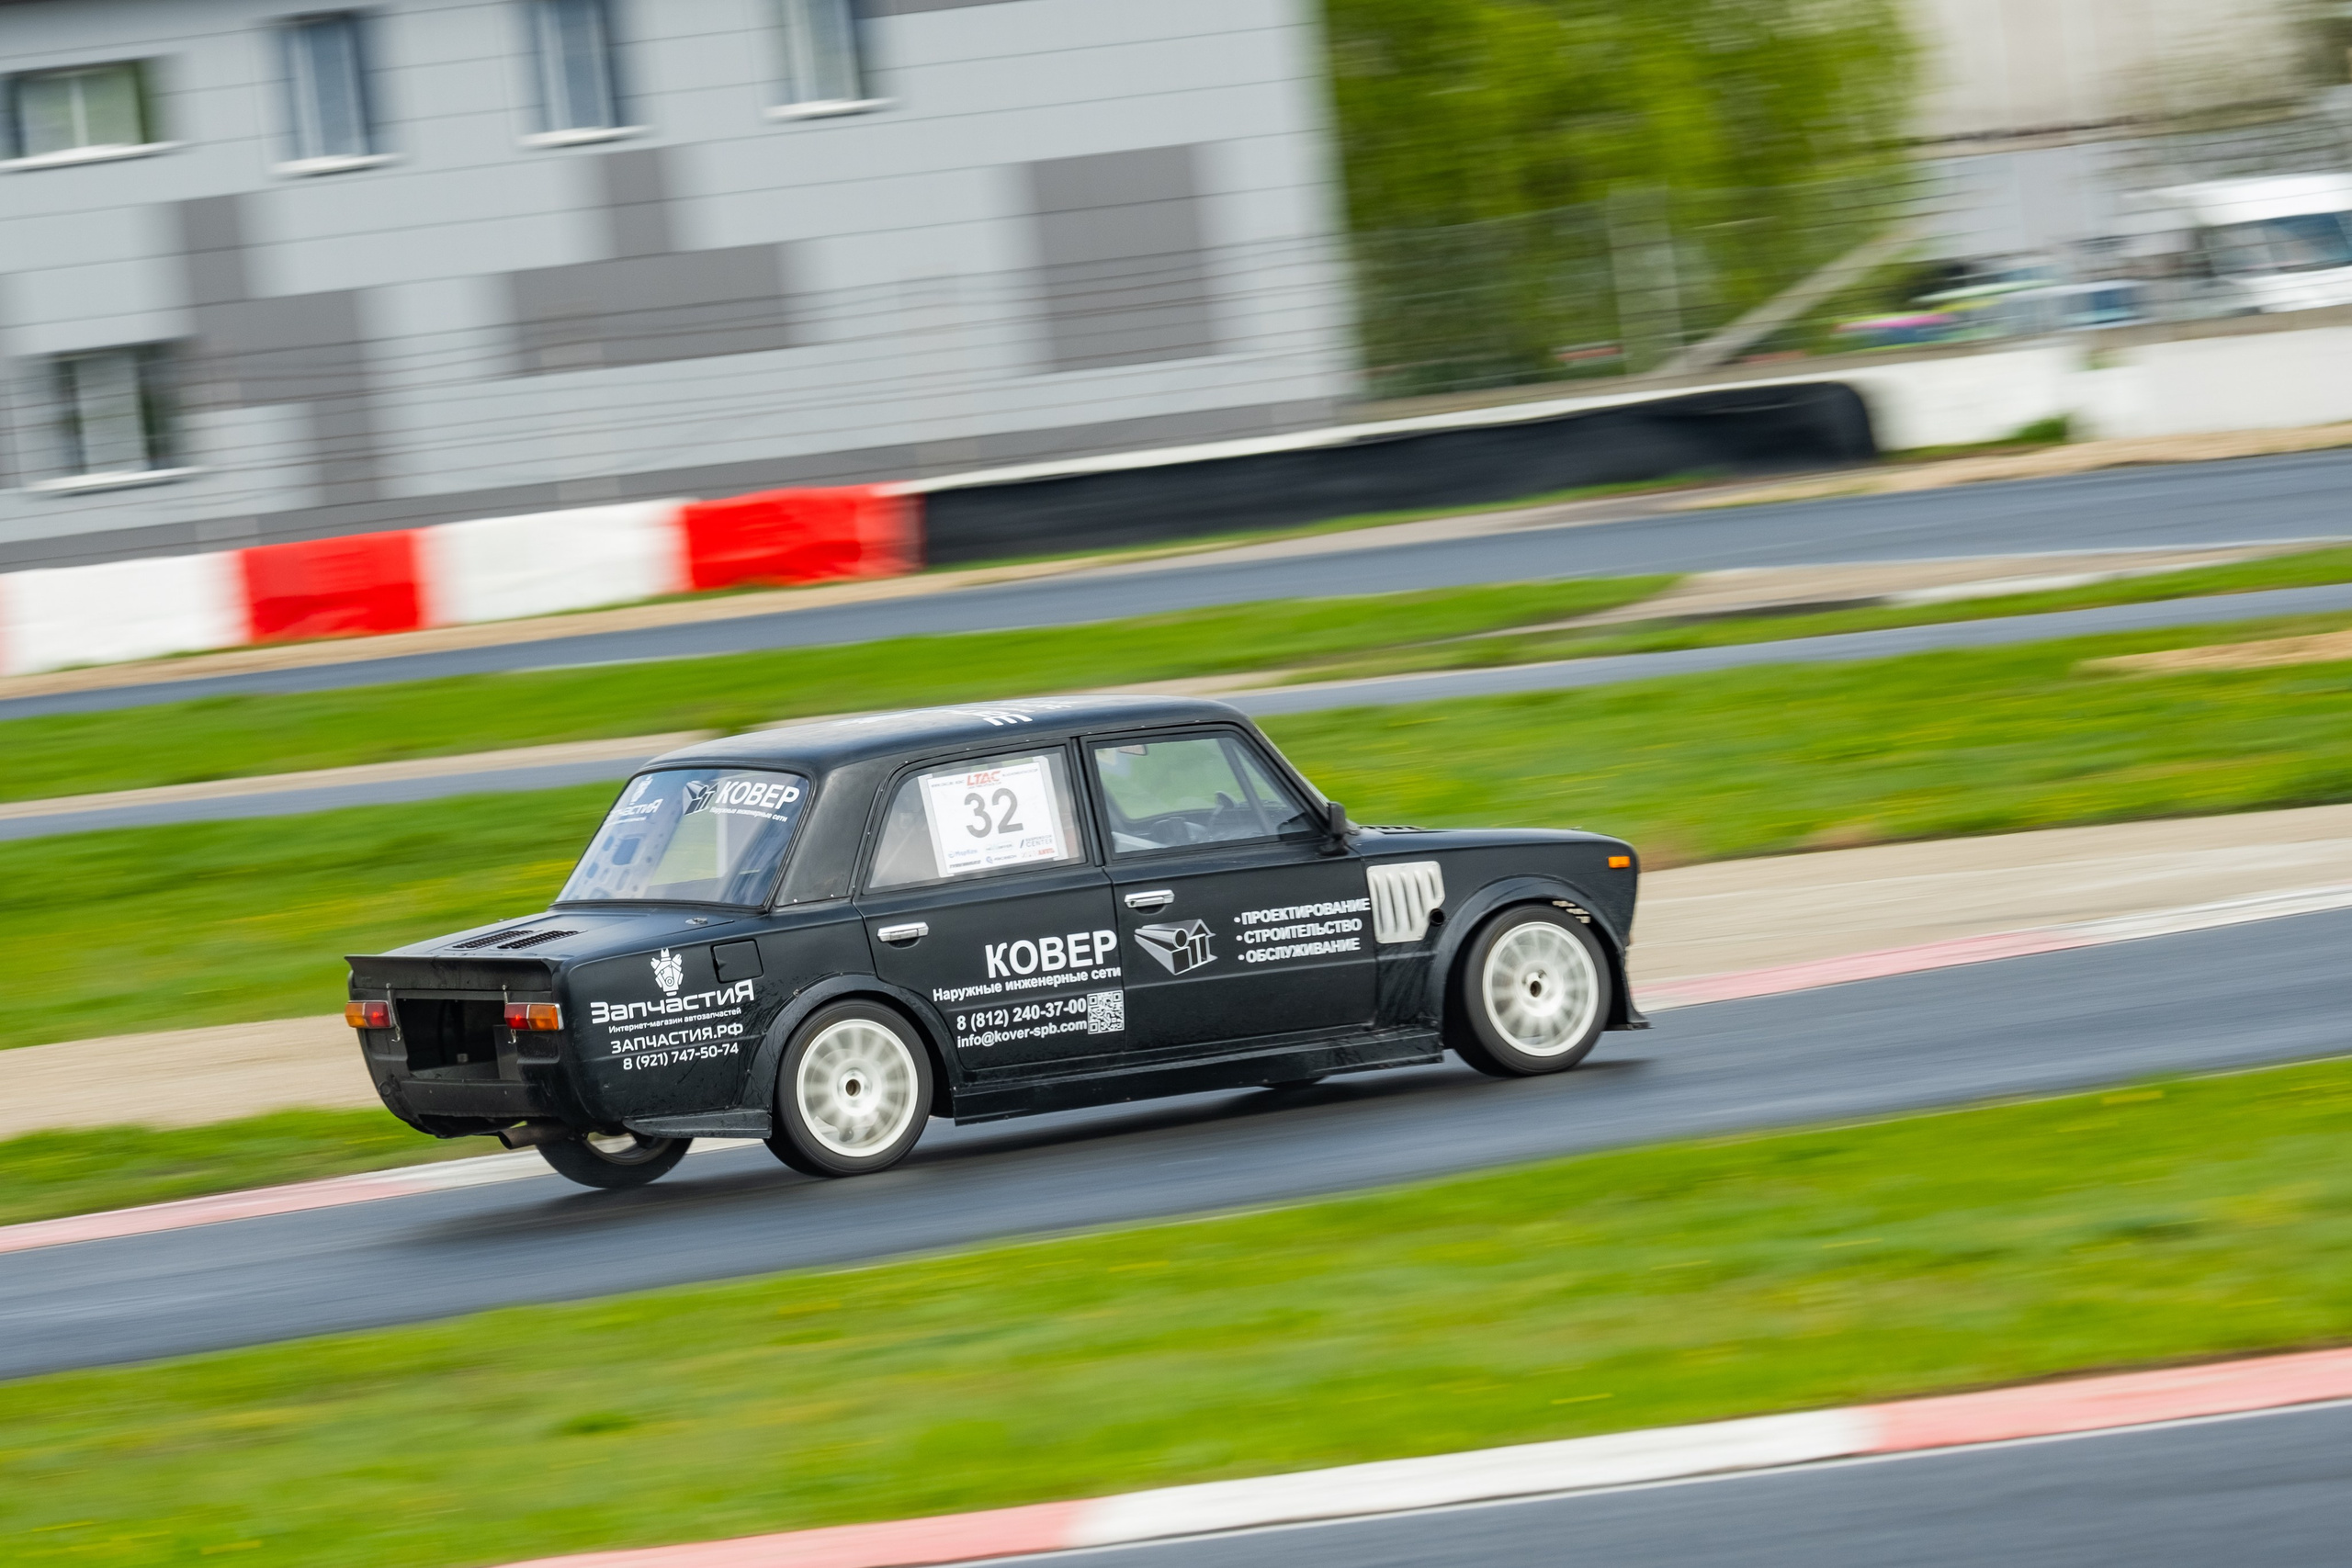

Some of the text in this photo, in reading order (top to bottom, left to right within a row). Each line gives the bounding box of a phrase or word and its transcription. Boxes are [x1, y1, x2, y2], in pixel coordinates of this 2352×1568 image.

[967, 771, 1001, 786] LTAC
[716, 781, 800, 810] КОВЕР
[964, 787, 1024, 839] 32
[1026, 839, 1053, 848] CENTER
[1241, 897, 1371, 925] ПРОЕКТИРОВАНИЕ
[1243, 919, 1363, 944] СТРОИТЕЛЬСТВО
[985, 930, 1118, 978] КОВЕР
[1246, 938, 1361, 963] ОБСЛУЖИВАНИЕ
[933, 966, 1122, 1002] Наружные инженерные сети
[608, 1007, 742, 1033] Интернет-магазин автозапчастей
[956, 998, 1087, 1032] 8 (812) 240-37-00
[610, 1022, 744, 1055] ЗАПЧАСТИЯ.РФ
[956, 1021, 1087, 1048] info@kover-spb.com
[623, 1043, 740, 1070] 8 (921) 747-50-74
